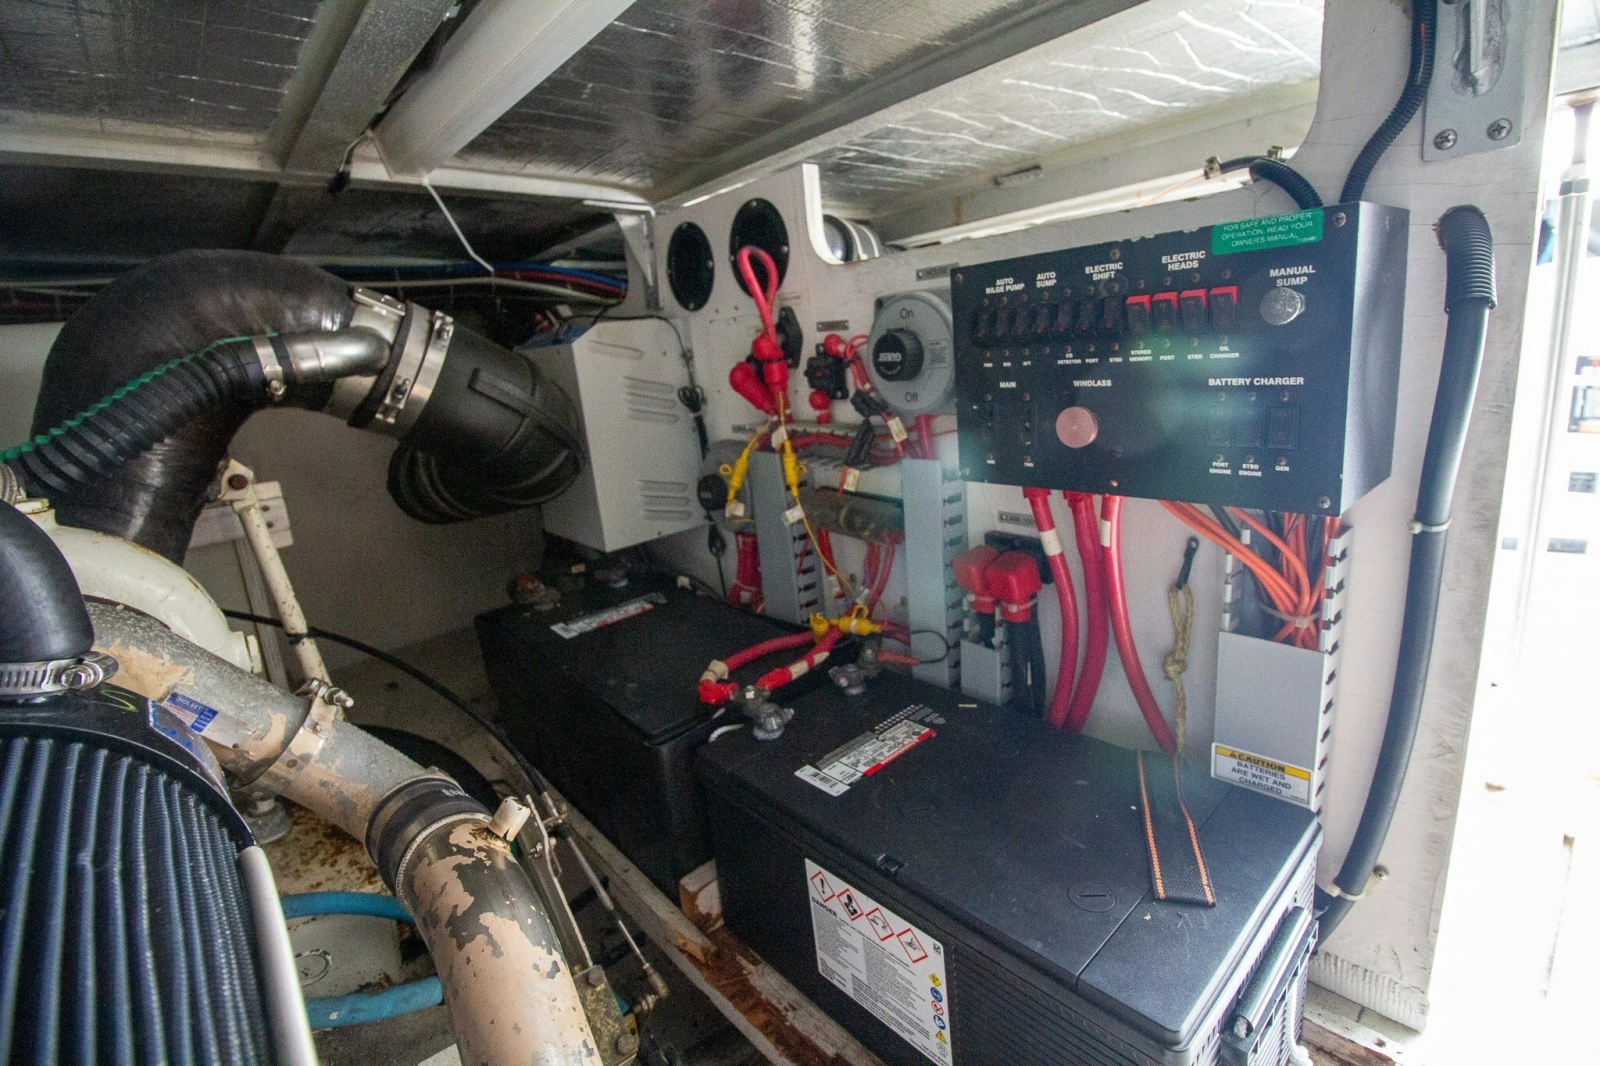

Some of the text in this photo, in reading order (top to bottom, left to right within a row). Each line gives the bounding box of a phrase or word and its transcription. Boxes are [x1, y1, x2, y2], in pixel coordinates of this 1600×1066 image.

[1223, 212, 1312, 232] FOR SAFE AND PROPER
[1267, 224, 1288, 233] READ
[1290, 221, 1313, 230] YOUR
[1161, 250, 1206, 264] ELECTRIC
[1085, 262, 1123, 274] ELECTRIC
[1167, 260, 1199, 271] HEADS
[1269, 265, 1316, 277] MANUAL
[995, 277, 1014, 286] AUTO
[1036, 271, 1056, 280] AUTO
[1092, 271, 1116, 281] SHIFT
[1276, 276, 1308, 287] SUMP
[986, 283, 1025, 294] BILGE PUMP
[1036, 279, 1057, 288] SUMP
[899, 308, 914, 319] On
[999, 381, 1017, 389] MAIN
[1073, 379, 1112, 387] WINDLASS
[1208, 376, 1304, 386] BATTERY CHARGER
[904, 391, 919, 403] Off
[177, 696, 203, 711] HOLSET
[1237, 753, 1285, 773] CAUTION
[1236, 761, 1286, 781] BATTERIES
[1231, 767, 1292, 790] ARE WET AND
[1238, 776, 1282, 795] CHARGED
[811, 896, 838, 918] DANGER
